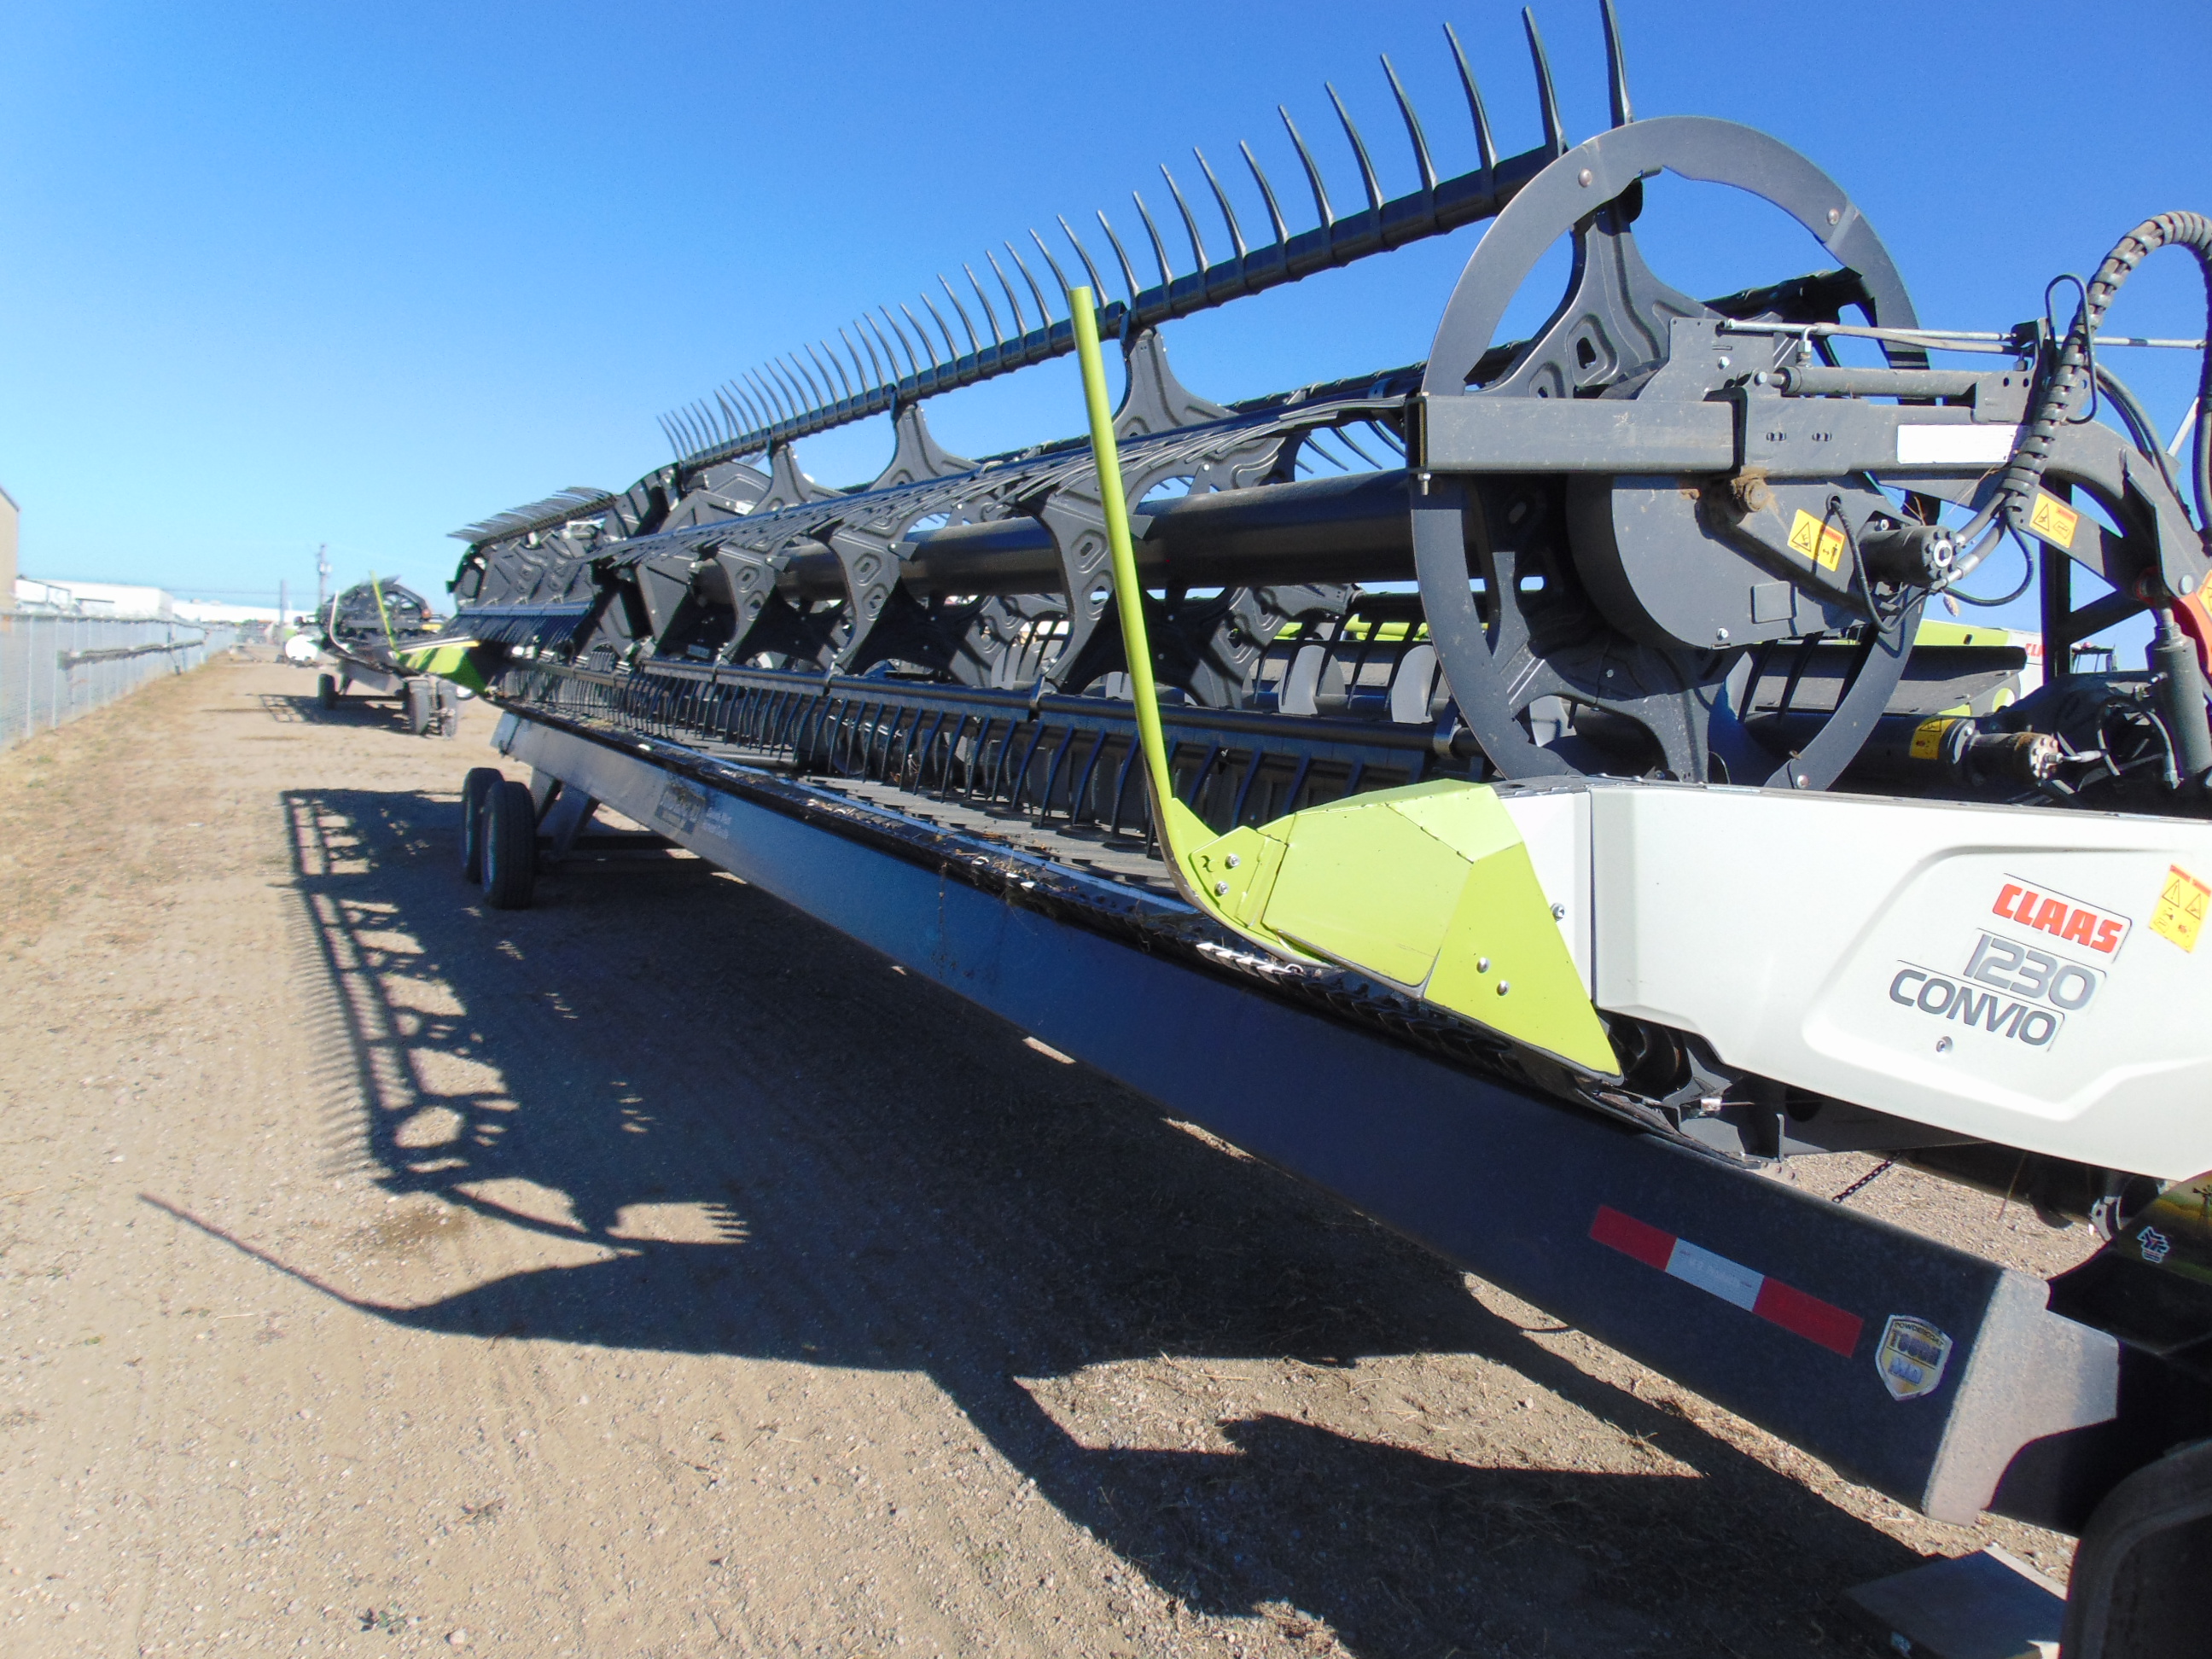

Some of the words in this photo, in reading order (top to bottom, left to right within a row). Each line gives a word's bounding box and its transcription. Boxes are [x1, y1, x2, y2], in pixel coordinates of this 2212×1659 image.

[1992, 883, 2123, 953] CLAAS
[1889, 968, 2058, 1046] CONVIO
[1963, 934, 2097, 1010] 1230
